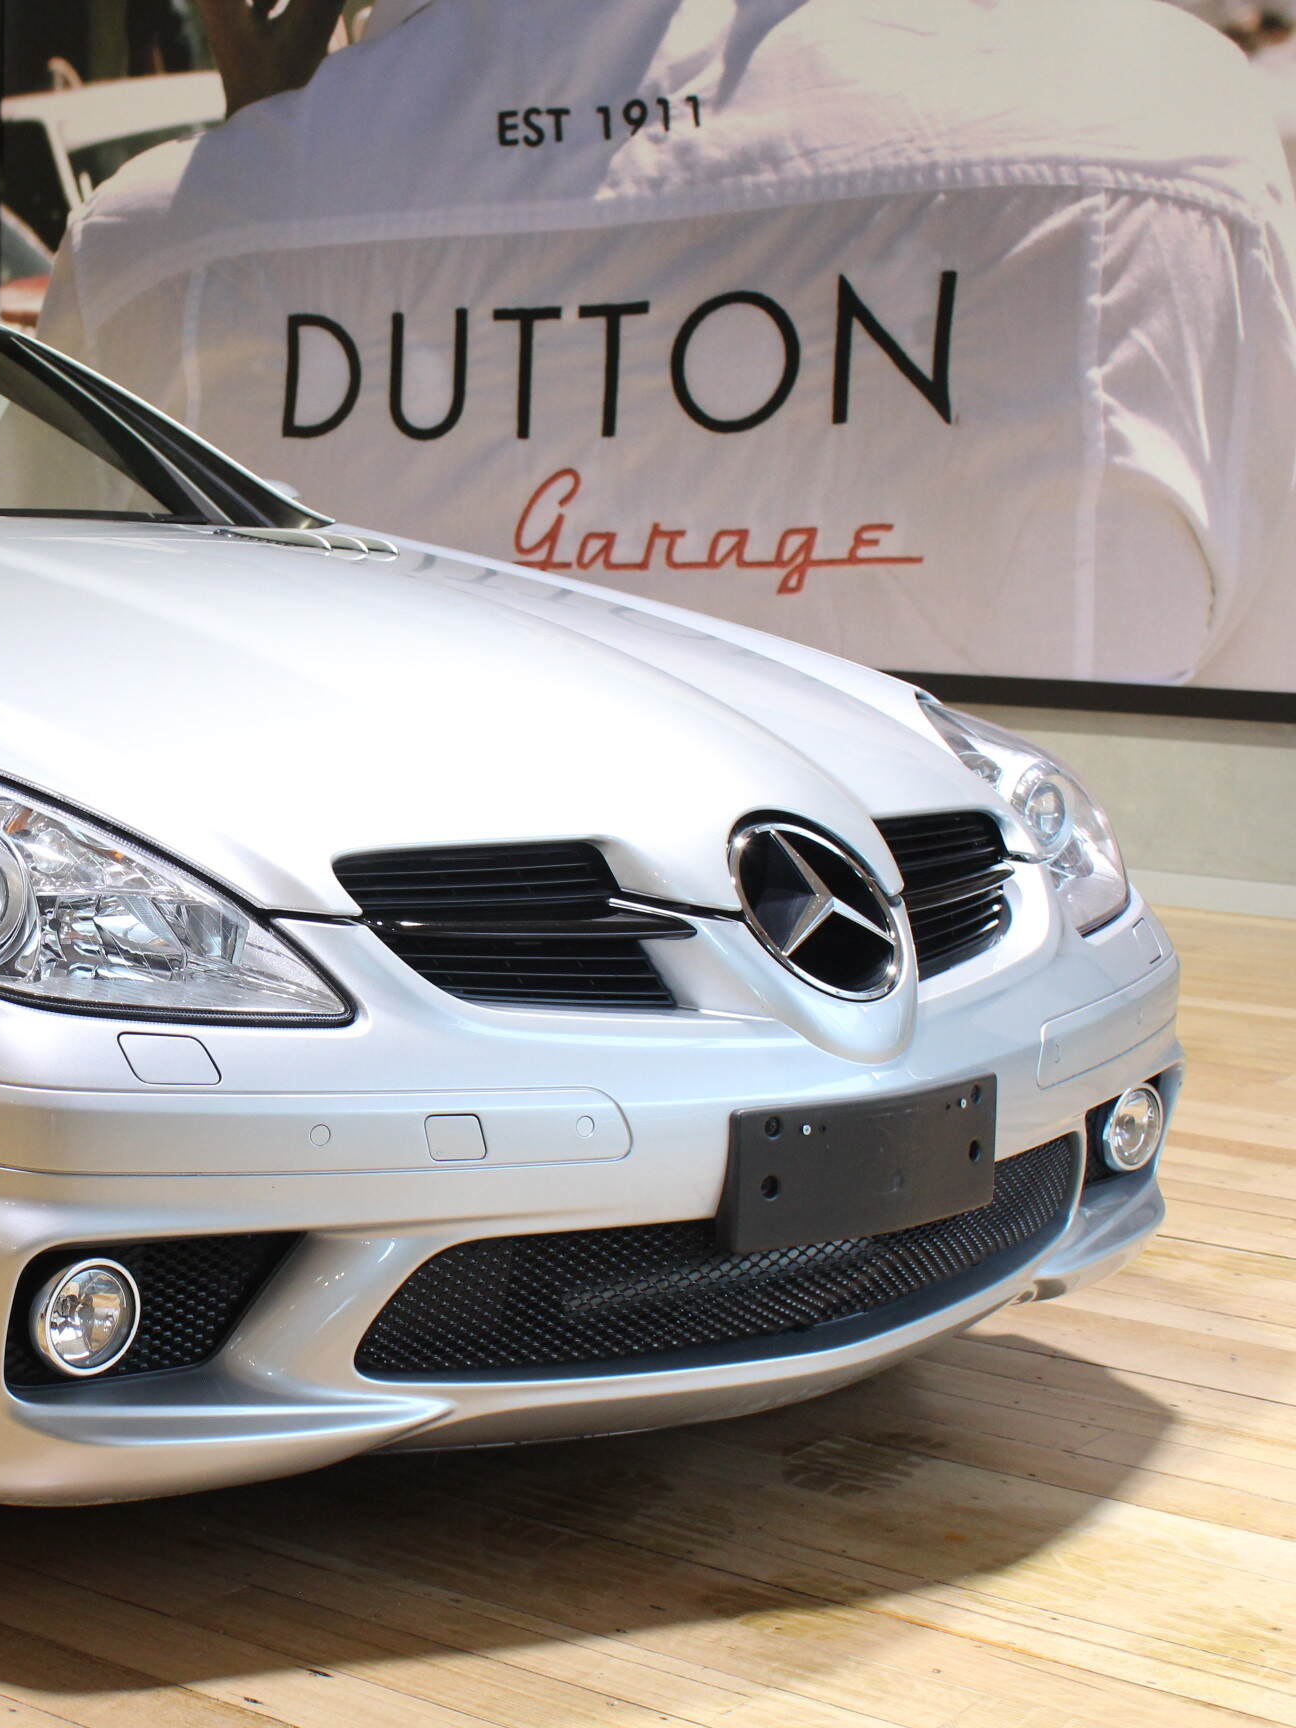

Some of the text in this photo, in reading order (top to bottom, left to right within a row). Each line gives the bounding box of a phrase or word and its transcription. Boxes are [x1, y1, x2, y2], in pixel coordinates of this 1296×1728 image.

[497, 94, 701, 148] EST 1911
[281, 269, 958, 441] DUTTON
[511, 467, 926, 597] Garage
